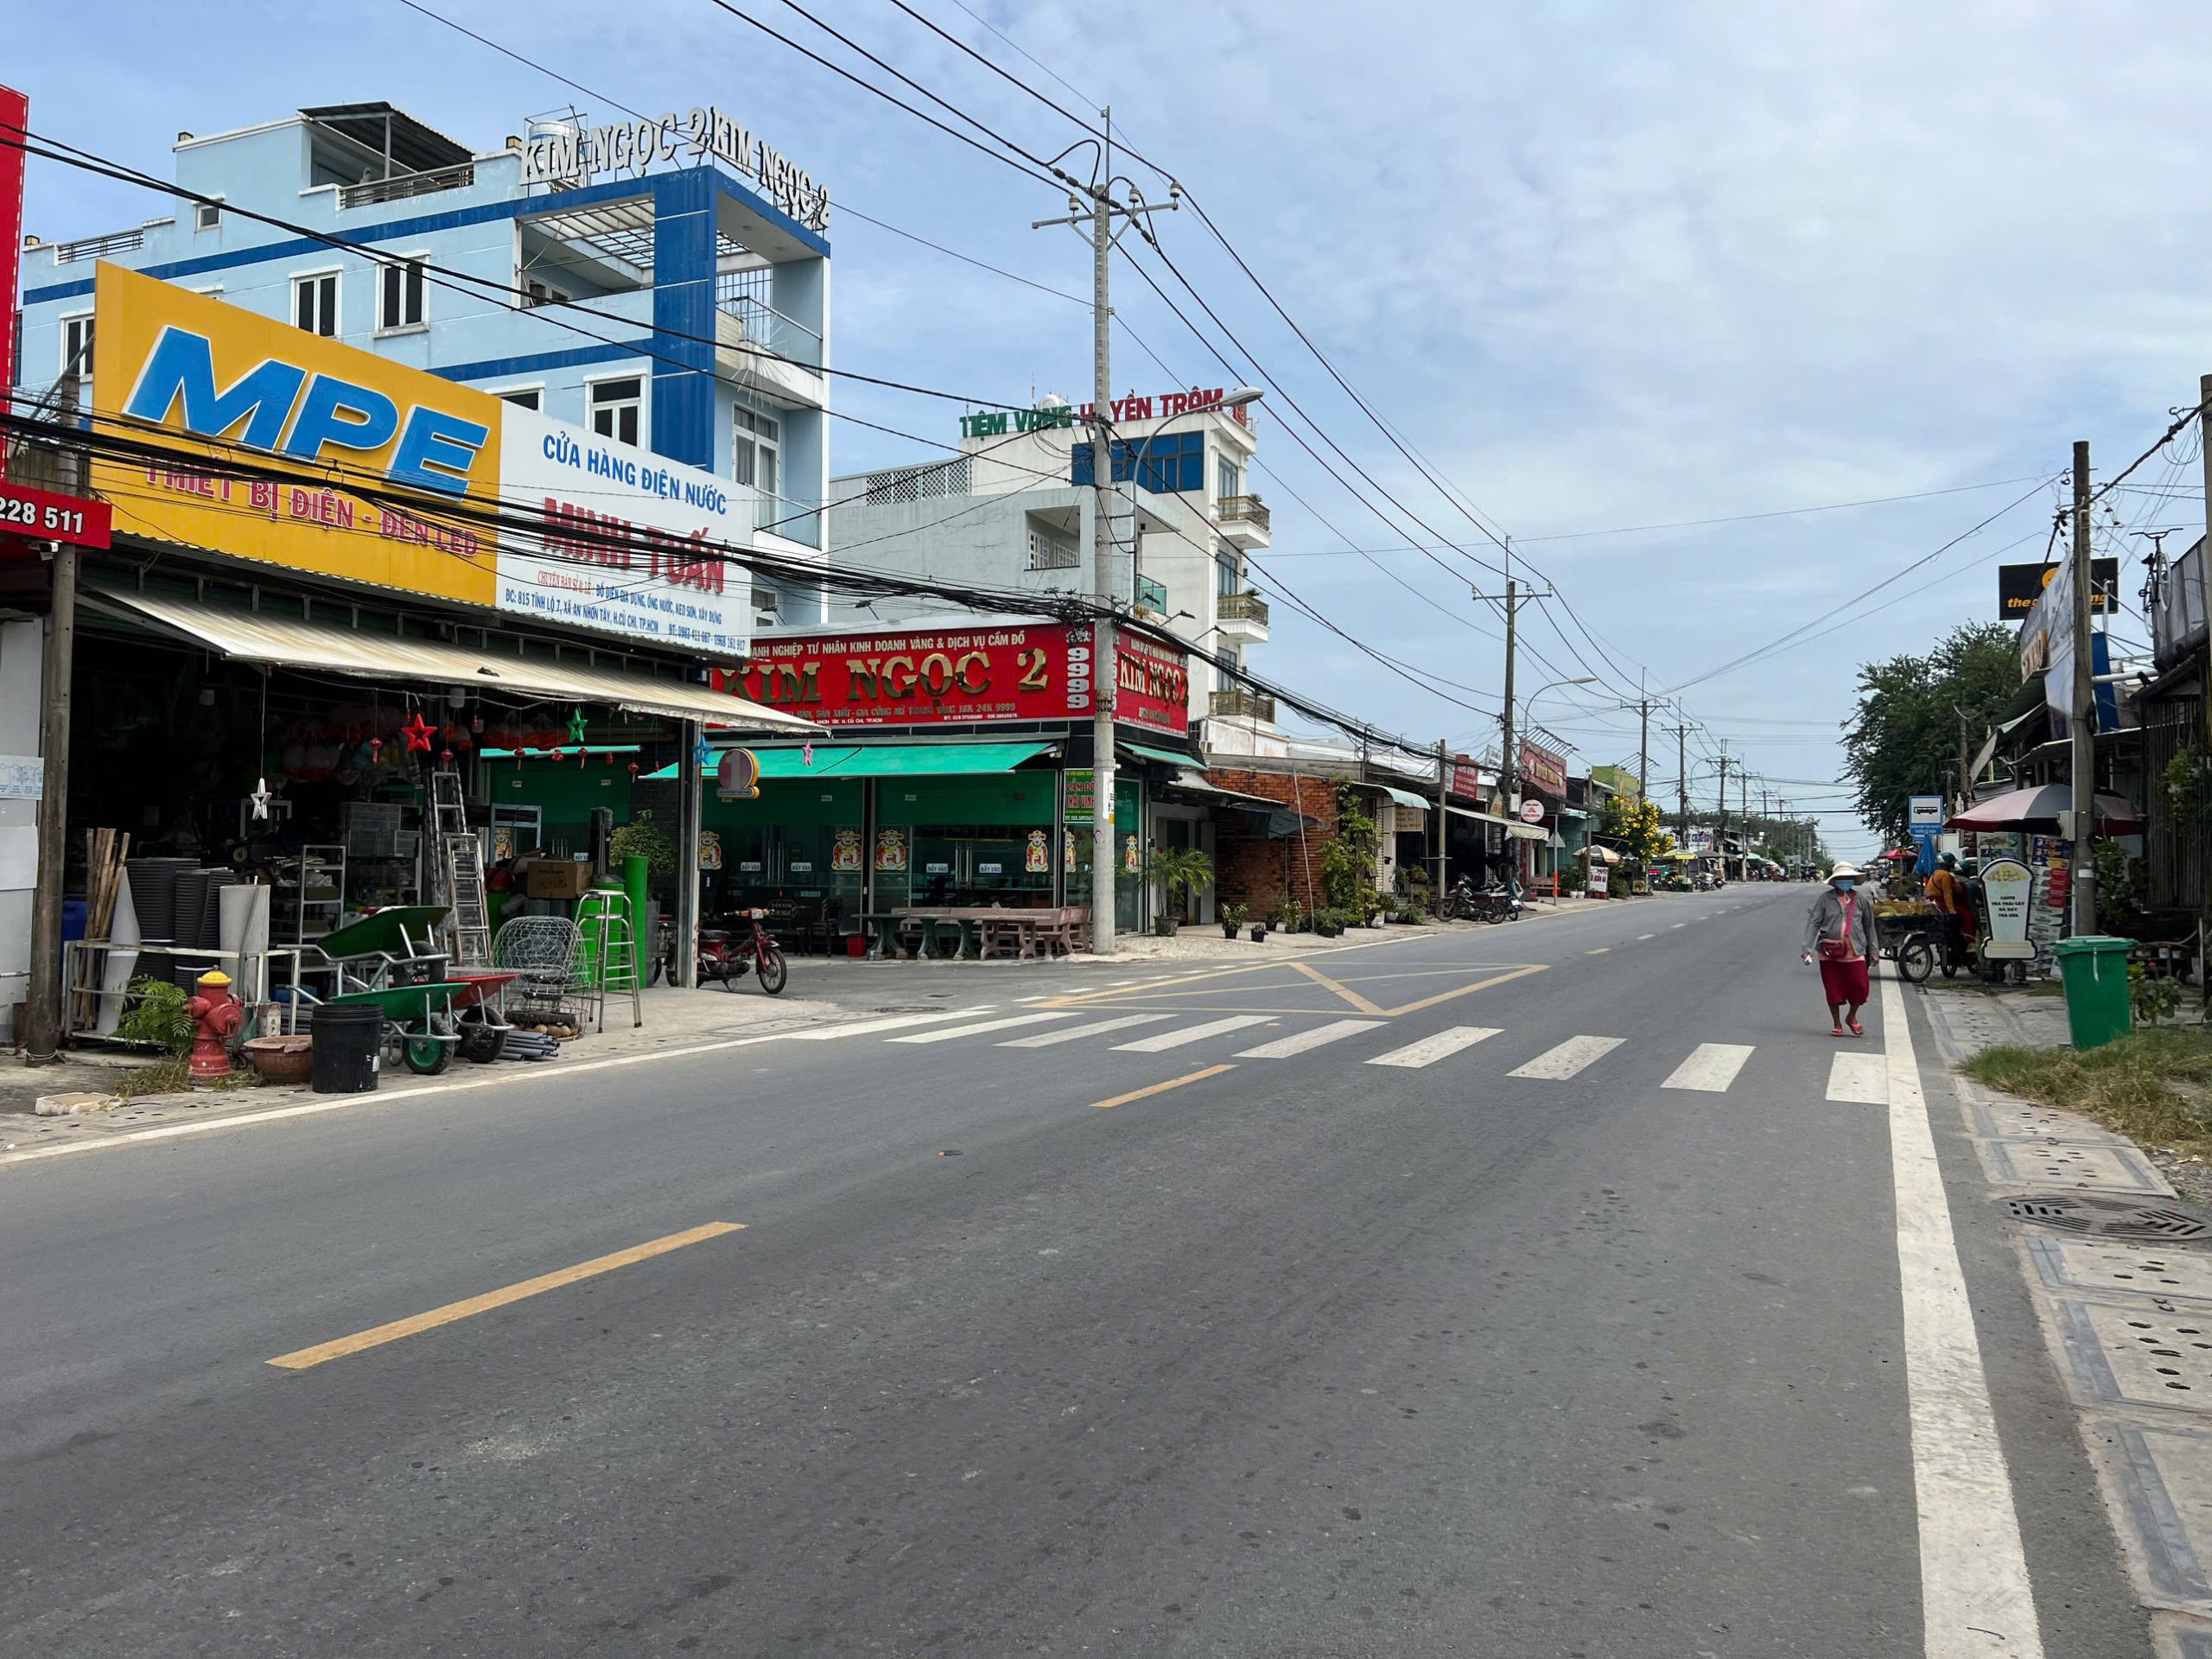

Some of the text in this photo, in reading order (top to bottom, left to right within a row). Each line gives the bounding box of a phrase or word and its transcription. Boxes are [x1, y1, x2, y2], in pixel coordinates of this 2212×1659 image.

[519, 107, 707, 186] KIM NGỌC 2
[710, 106, 830, 232] KIM NGỌC 2
[122, 325, 491, 502] MPE
[959, 385, 1224, 442] TIỆM VÀNG HYỀN TRÔM
[543, 430, 727, 516] CỬA HÀNG ĐIỆN NƯỚC
[44, 505, 84, 534] 511
[144, 455, 233, 501] THIẾT
[250, 478, 281, 522] BỊ
[289, 487, 354, 531] ĐIỆN
[379, 508, 429, 547] ĐÈN
[435, 523, 479, 557] LED
[542, 497, 726, 594] MINH TUẤN
[505, 588, 516, 604] ĐC:
[518, 592, 530, 607] 815
[547, 596, 555, 613] LỘ
[563, 600, 571, 614] XÃ
[573, 603, 582, 616] AN
[583, 605, 598, 620] NHƠN
[639, 618, 658, 632] TP.HCM
[620, 589, 629, 603] GIA
[676, 602, 685, 616] KEO
[698, 607, 708, 622] XÂY
[772, 642, 804, 658] NGHIỆP
[807, 642, 820, 655] TƯ
[823, 640, 847, 654] NHÂN
[849, 640, 871, 653] KINH
[875, 639, 906, 652] DOANH
[910, 636, 934, 650] VÀNG
[937, 638, 944, 648] &
[948, 636, 969, 651] DỊCH
[973, 635, 985, 650] VỤ
[988, 631, 1008, 646] CẦM
[1011, 630, 1025, 645] ĐỒ
[1119, 651, 1147, 695] KIM
[720, 647, 1049, 706] KIM NGỌC 2
[1066, 647, 1090, 710] 9999
[959, 703, 974, 713] 18K
[976, 703, 993, 712] 24K
[995, 702, 1016, 712] 9999
